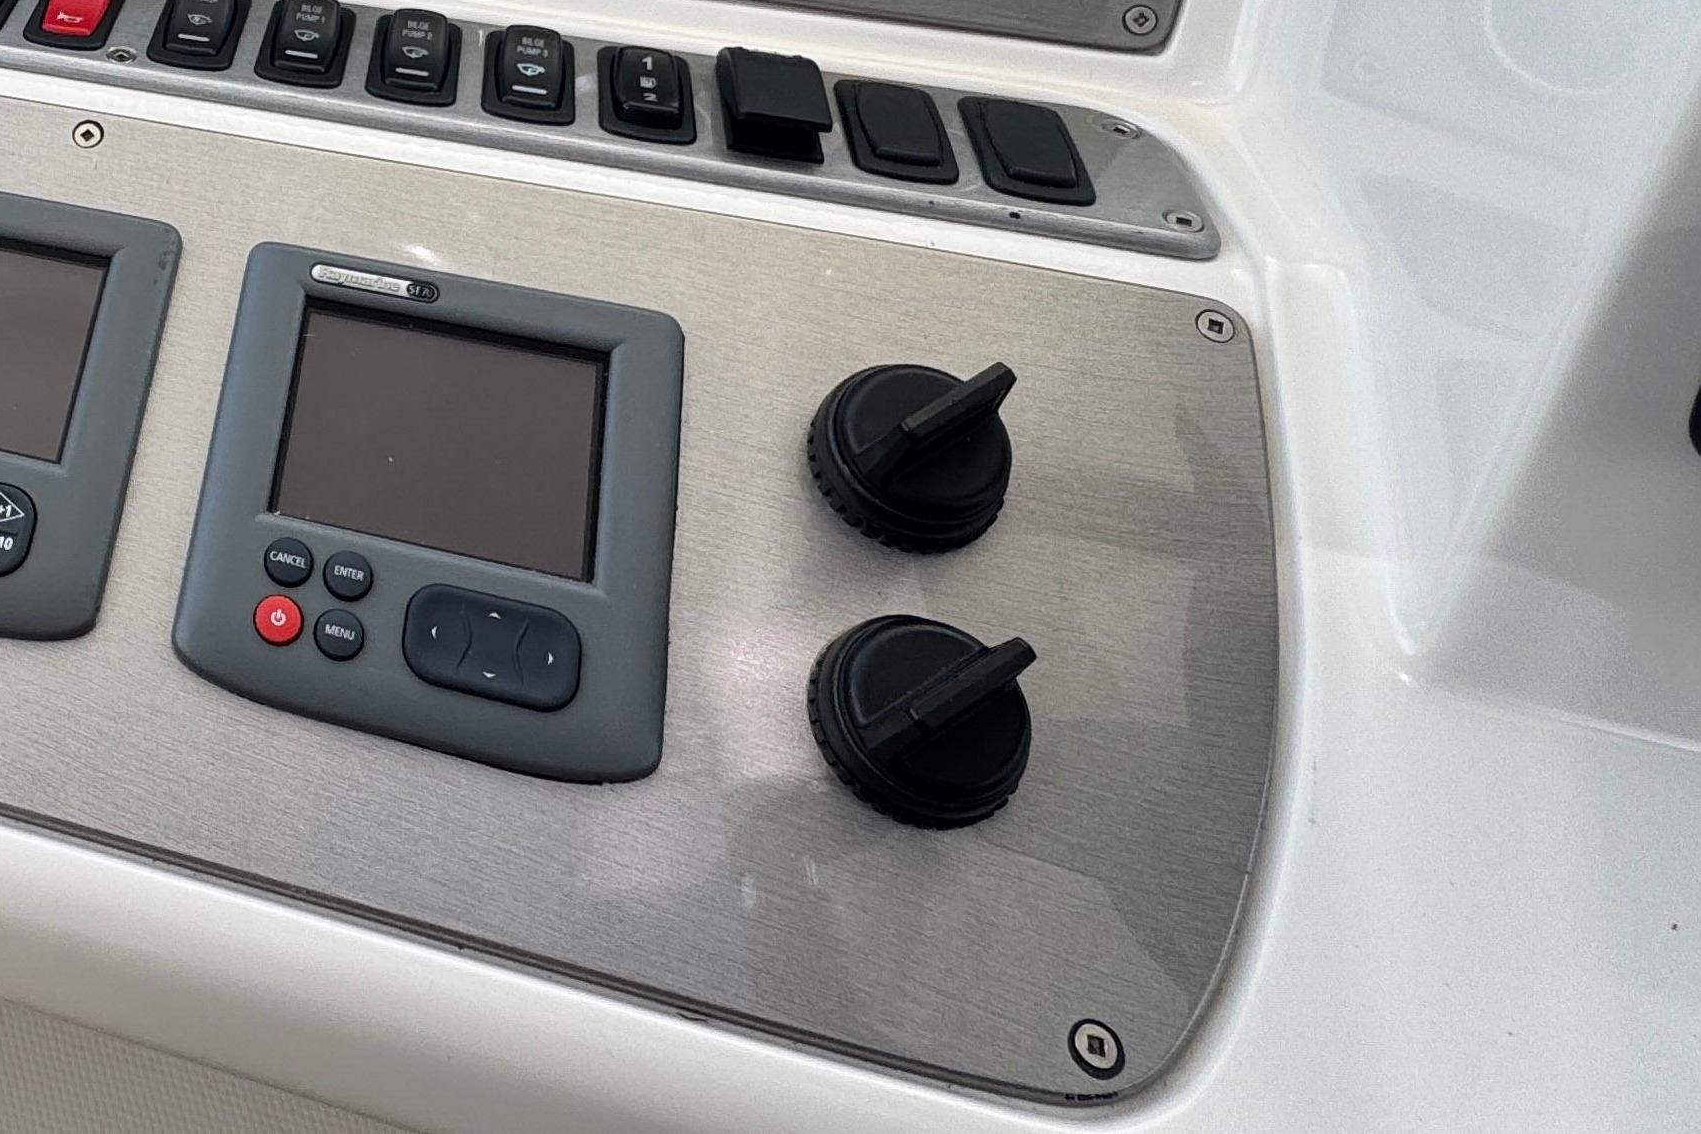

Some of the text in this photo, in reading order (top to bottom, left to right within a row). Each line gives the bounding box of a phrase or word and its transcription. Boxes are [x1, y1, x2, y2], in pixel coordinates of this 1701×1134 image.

[642, 56, 653, 71] 1
[269, 550, 307, 569] CANCEL
[333, 564, 365, 582] ENTER
[324, 623, 356, 641] MENU
